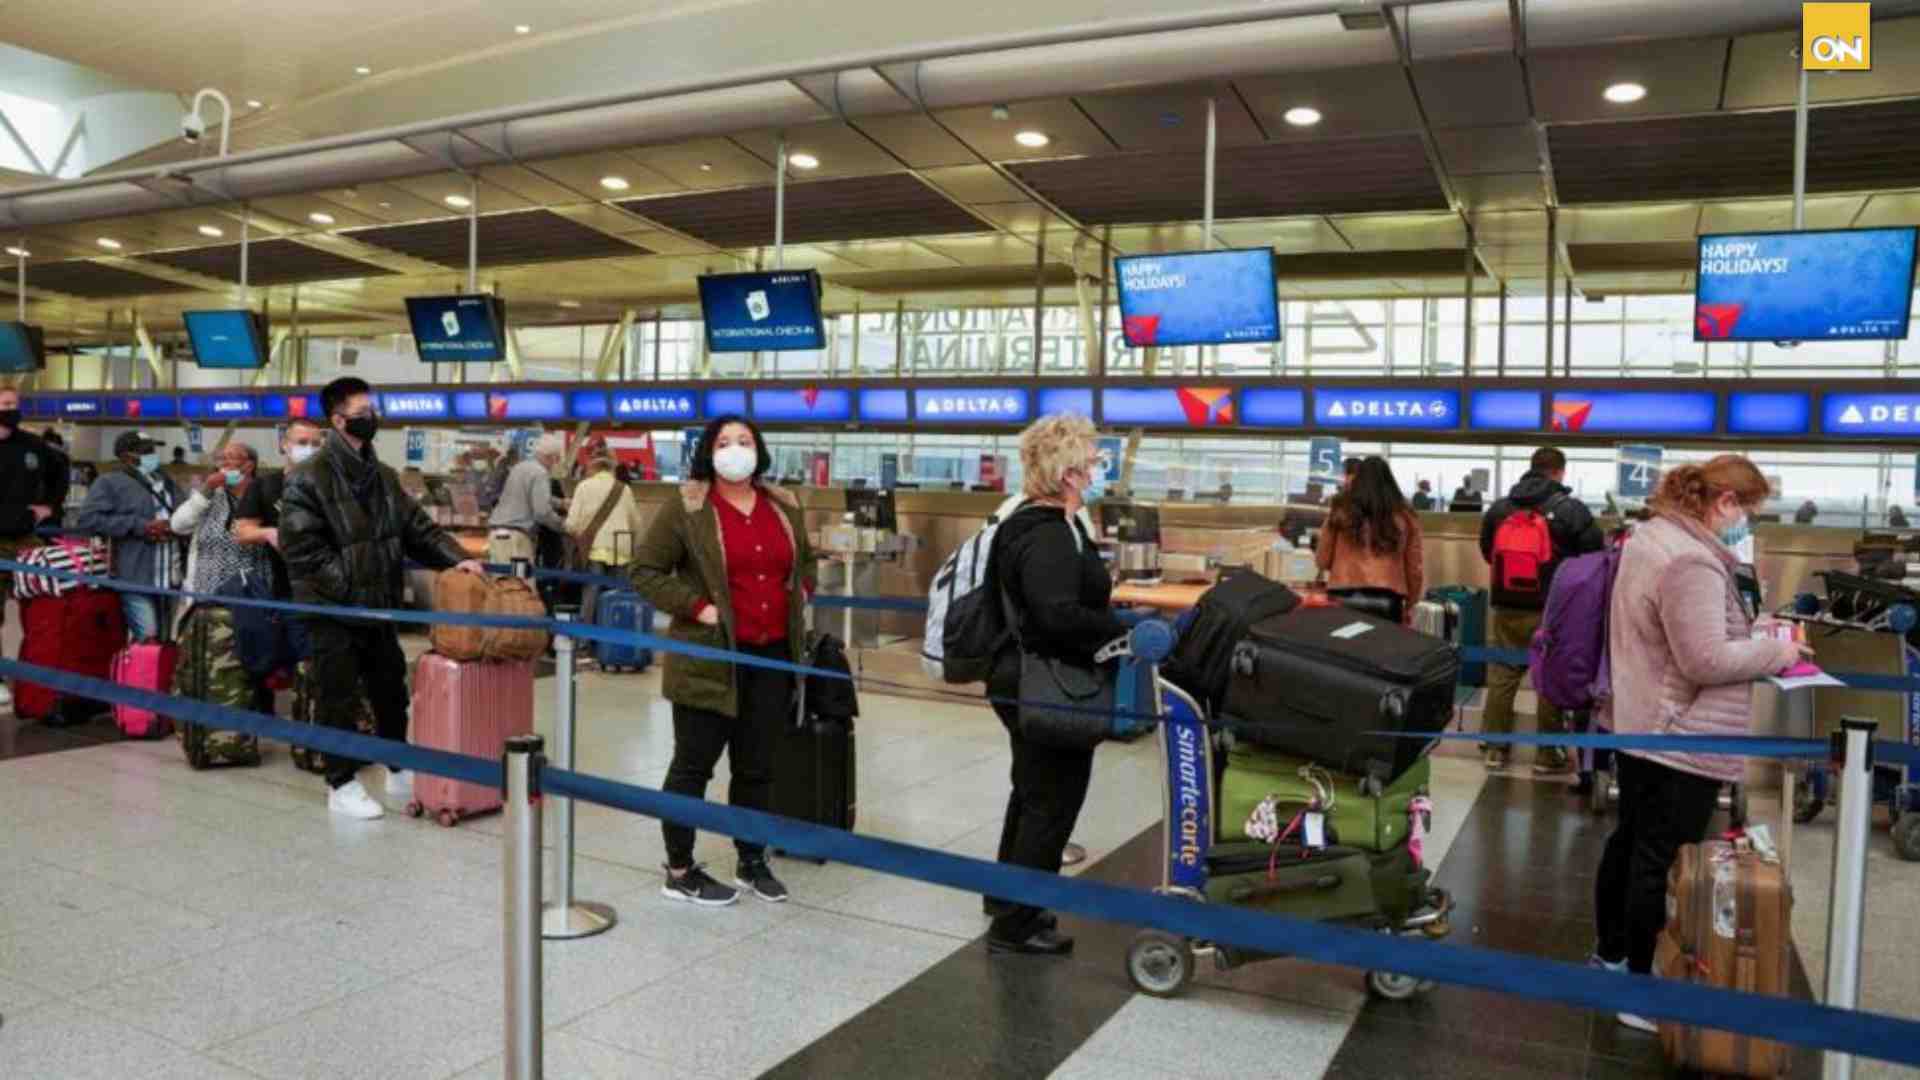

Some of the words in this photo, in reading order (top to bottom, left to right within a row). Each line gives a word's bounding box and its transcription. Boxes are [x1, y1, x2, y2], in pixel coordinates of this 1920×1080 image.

[1701, 242, 1758, 258] HAPPY
[1121, 262, 1161, 274] HAPPY
[1701, 257, 1787, 275] HOLIDAYS!
[1122, 273, 1186, 290] HOLIDAYS!
[632, 397, 676, 412] DELTA
[943, 397, 1000, 413] DELTA
[1351, 399, 1424, 417] DELTA
[1318, 448, 1334, 475] 5
[1629, 461, 1650, 489] 4
